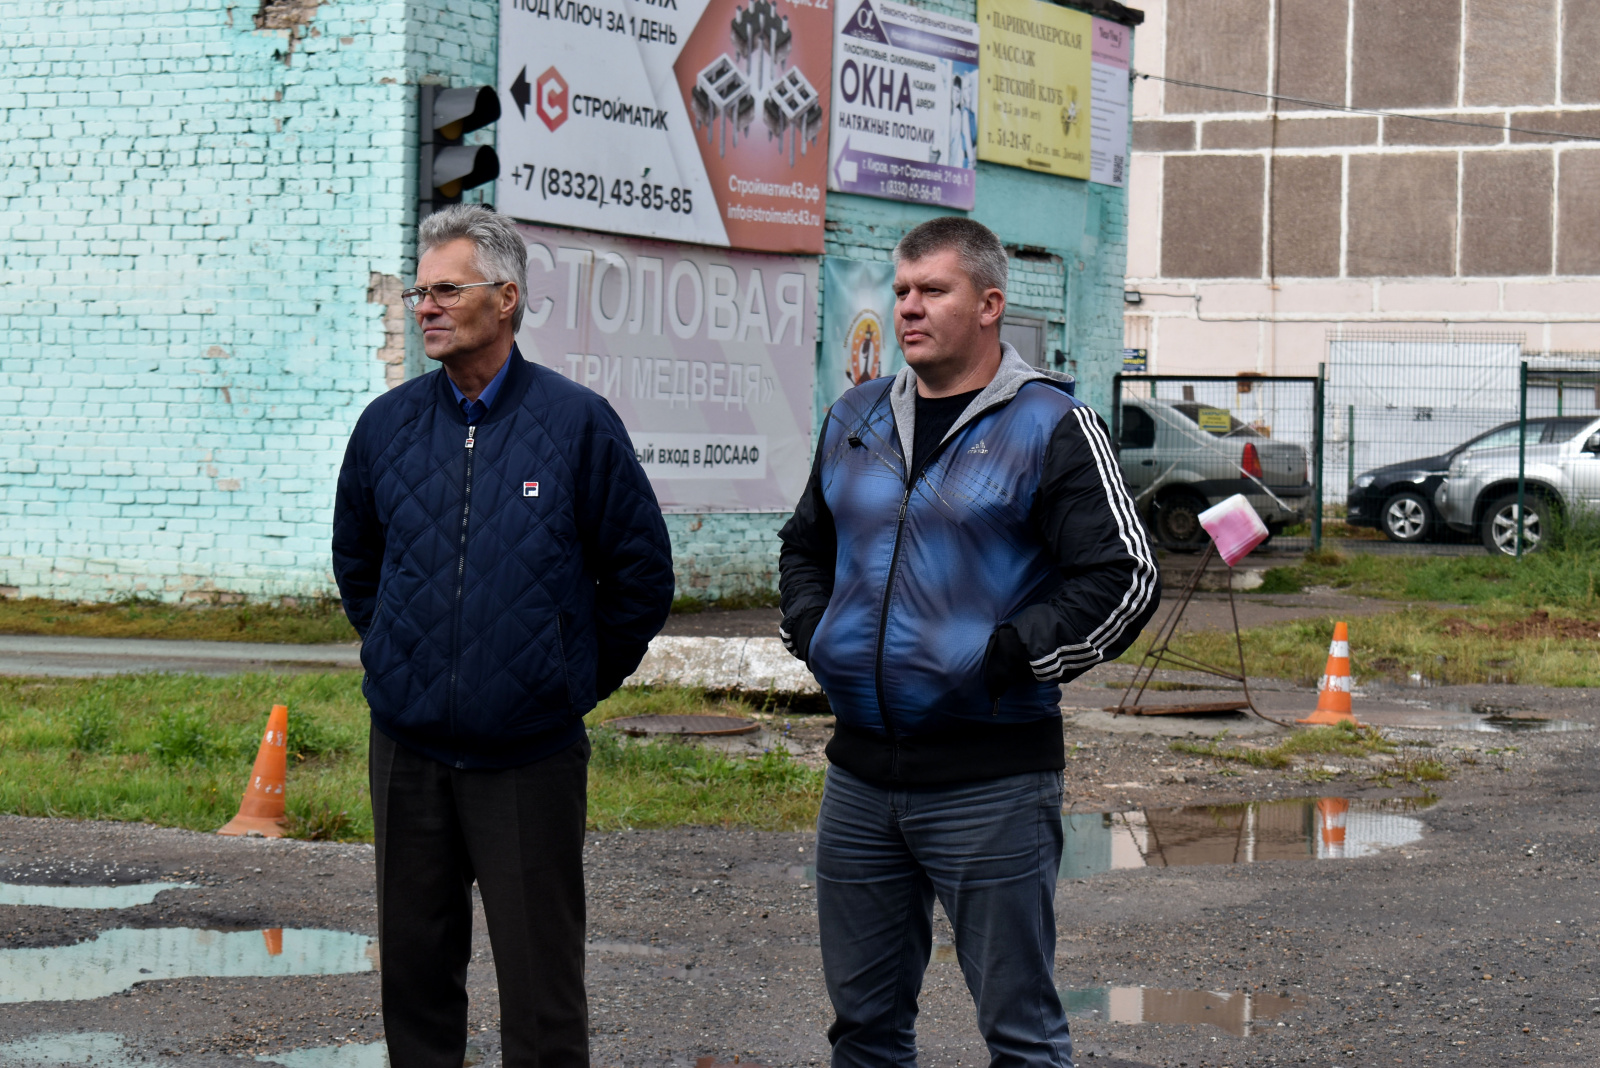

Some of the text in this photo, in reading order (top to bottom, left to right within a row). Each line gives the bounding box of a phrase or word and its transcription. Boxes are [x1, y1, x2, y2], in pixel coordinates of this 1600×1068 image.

[555, 1, 602, 29] КЛЮЧ
[606, 11, 626, 34] ЗА
[629, 17, 636, 37] 1
[638, 19, 677, 45] ДЕНЬ
[993, 11, 1082, 50] ПАРИКМАХЕРСКАЯ
[992, 41, 1036, 67] МАССАЖ
[840, 58, 913, 115] ОКНА
[992, 74, 1036, 100] ДЕТСКИЙ
[1038, 85, 1063, 106] КЛУБ
[572, 94, 669, 131] СТРОЙМАТИК
[839, 111, 935, 144] НАТЯЖНЫЕ ПОТОЛКИ
[511, 163, 692, 215] +7 (8332) 43-85-85
[728, 174, 820, 204] Стройматик43.рф
[727, 202, 820, 227] info@stroimatic43.ru
[523, 242, 806, 347] СТОЛОВАЯ
[632, 356, 774, 411] МЕДВЕДЯ»
[634, 443, 760, 468] ый вход в ДОСААФ
